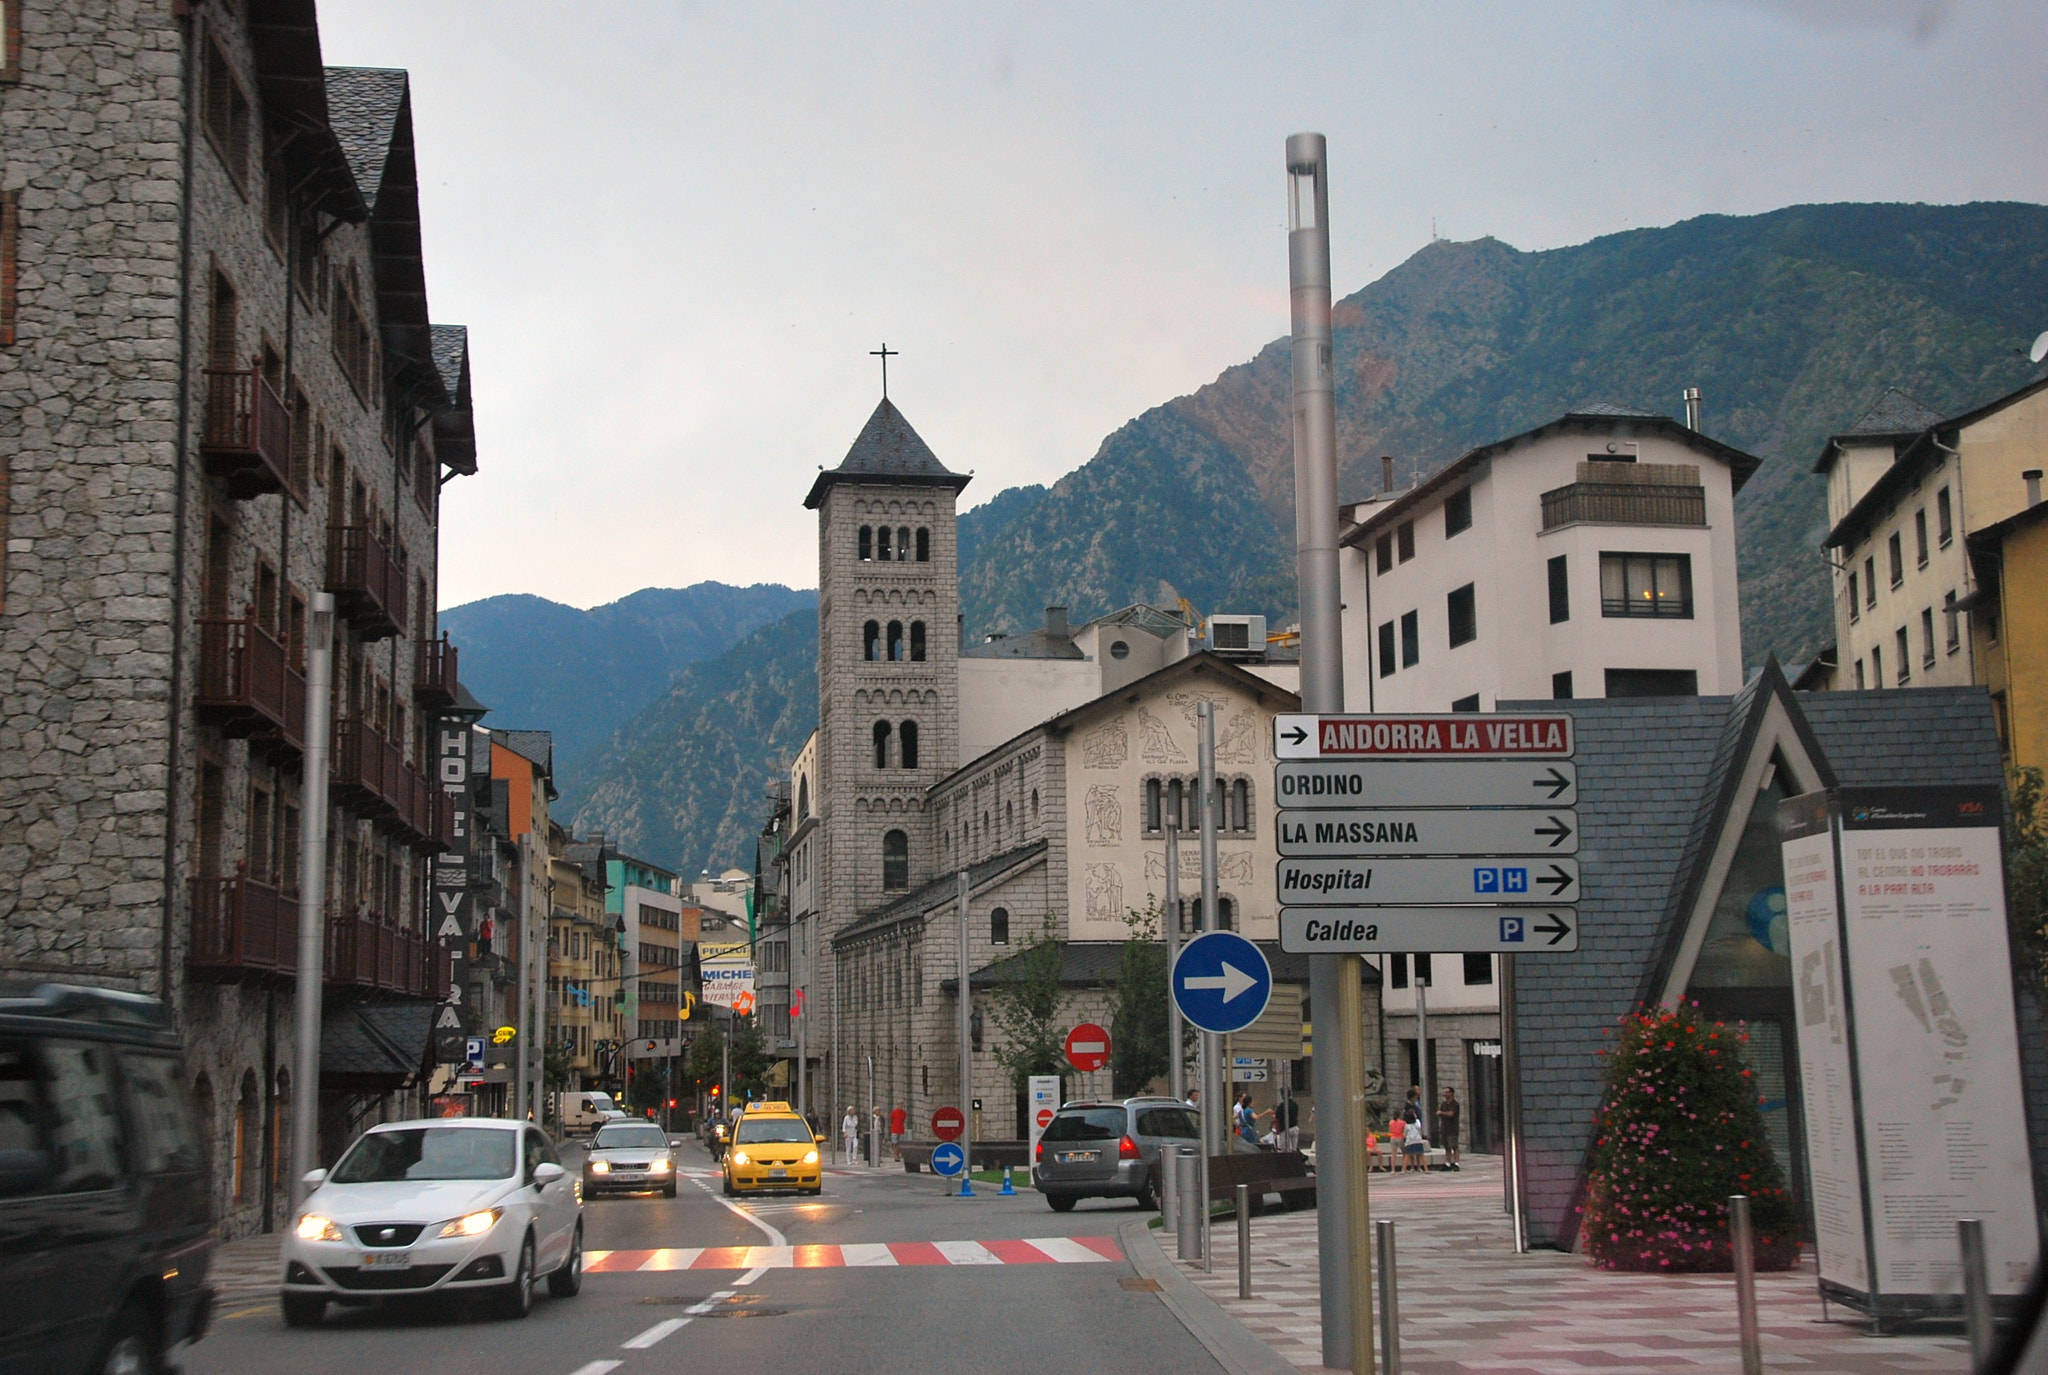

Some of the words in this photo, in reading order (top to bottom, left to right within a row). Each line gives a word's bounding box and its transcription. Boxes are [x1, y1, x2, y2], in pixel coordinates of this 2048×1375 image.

[1322, 724, 1442, 750] ANDORRA
[1450, 724, 1480, 749] LA
[1486, 723, 1563, 749] VELLA
[1281, 774, 1363, 796] ORDINO
[1282, 824, 1308, 844] LA
[1315, 822, 1419, 844] MASSANA
[1284, 869, 1373, 894] Hospital
[1478, 871, 1495, 891] P
[1507, 871, 1523, 889] H
[1868, 884, 1881, 896] LA
[1911, 882, 1935, 895] ALTA
[1305, 920, 1379, 942] Caldea
[1504, 920, 1520, 939] P
[702, 946, 748, 956] PEUGEOT
